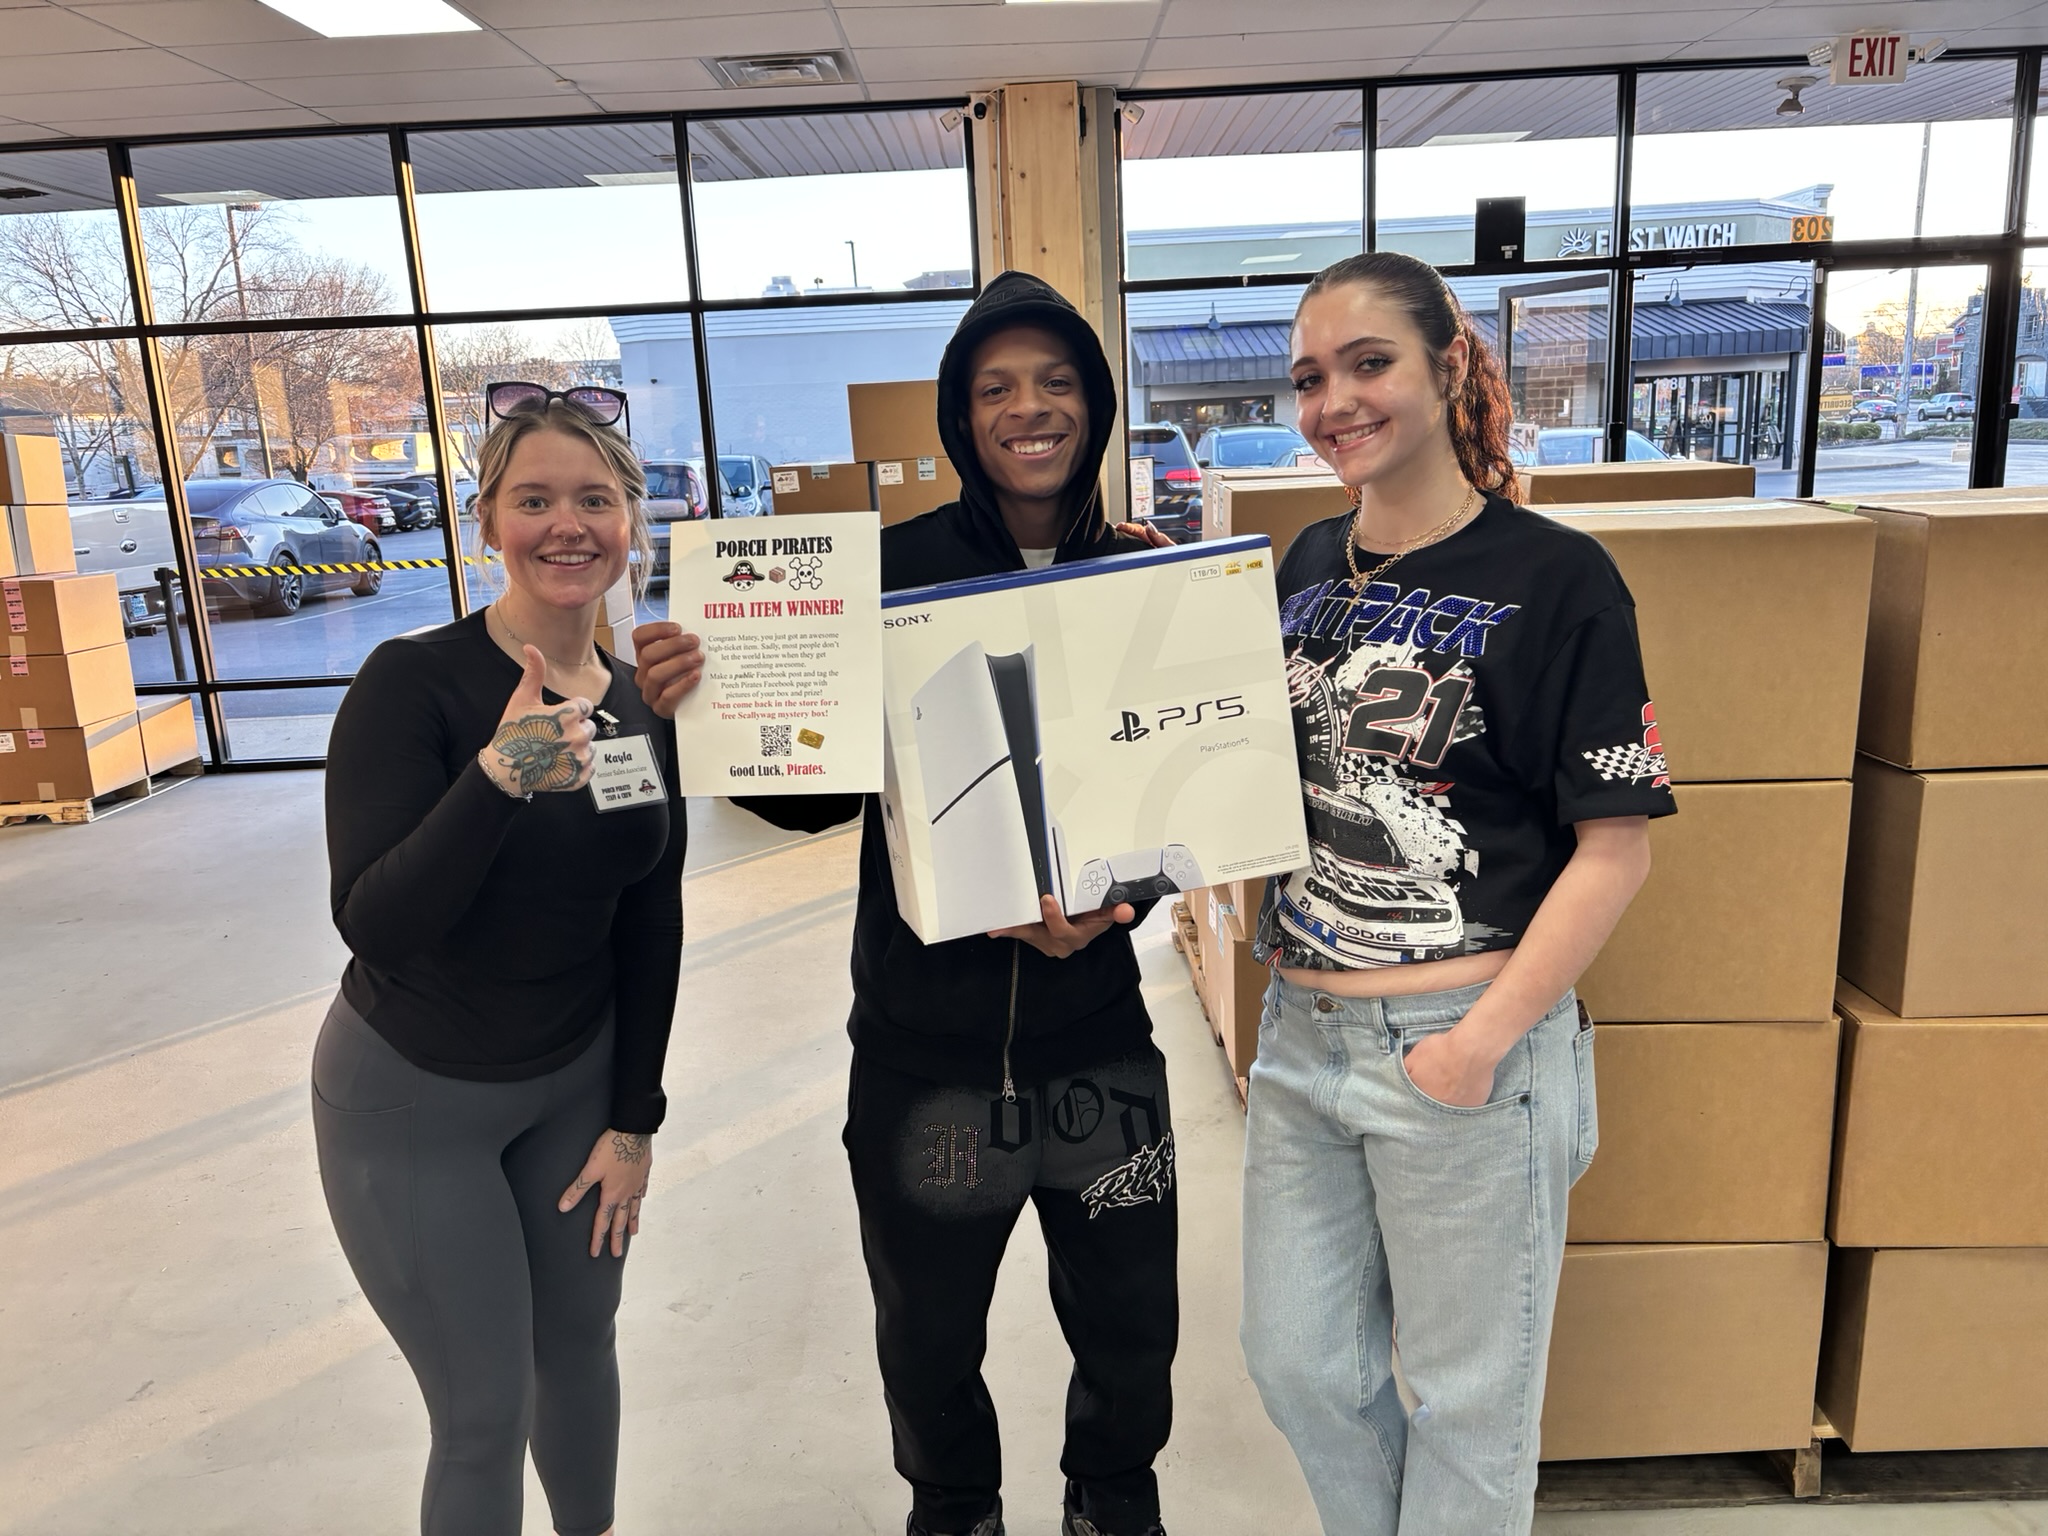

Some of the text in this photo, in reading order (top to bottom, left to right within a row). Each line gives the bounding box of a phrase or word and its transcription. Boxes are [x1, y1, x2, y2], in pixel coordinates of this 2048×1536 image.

[1848, 36, 1901, 77] EXIT
[1595, 222, 1738, 256] FST WATCH
[716, 536, 833, 558] PORCH PIRATES
[704, 599, 844, 619] ULTRA ITEM WINNER!
[883, 613, 931, 629] SONY
[708, 635, 736, 643] Congrats
[738, 634, 760, 642] Matey,
[774, 633, 787, 641] just
[788, 633, 798, 641] got
[708, 644, 742, 653] high-ticket
[761, 642, 781, 651] Sadly,
[799, 641, 821, 650] people
[800, 651, 814, 660] they
[816, 651, 826, 660] get
[740, 662, 774, 670] something
[734, 672, 755, 681] public
[756, 671, 787, 679] Facebook
[788, 671, 802, 679] post
[803, 670, 816, 678] and
[741, 681, 762, 689] Pirates
[763, 680, 795, 688] Facebook
[796, 681, 812, 689] page
[726, 691, 751, 700] pictures
[760, 691, 775, 699] your
[790, 689, 803, 697] and
[804, 689, 823, 698] prize!
[711, 701, 731, 709] Then
[754, 700, 773, 708] back
[784, 699, 798, 707] the
[799, 699, 818, 707] store
[820, 698, 831, 706] for
[721, 709, 829, 720] free Scallywag mystery box!
[1157, 695, 1245, 731] PS5
[1341, 667, 1476, 770] 21
[604, 751, 633, 765] Kayla
[596, 771, 613, 779] Senior
[613, 768, 626, 776] Sales
[730, 763, 826, 777] Good Luck, Pirates.
[601, 786, 615, 794] PORCH
[1335, 920, 1407, 943] DODGE
